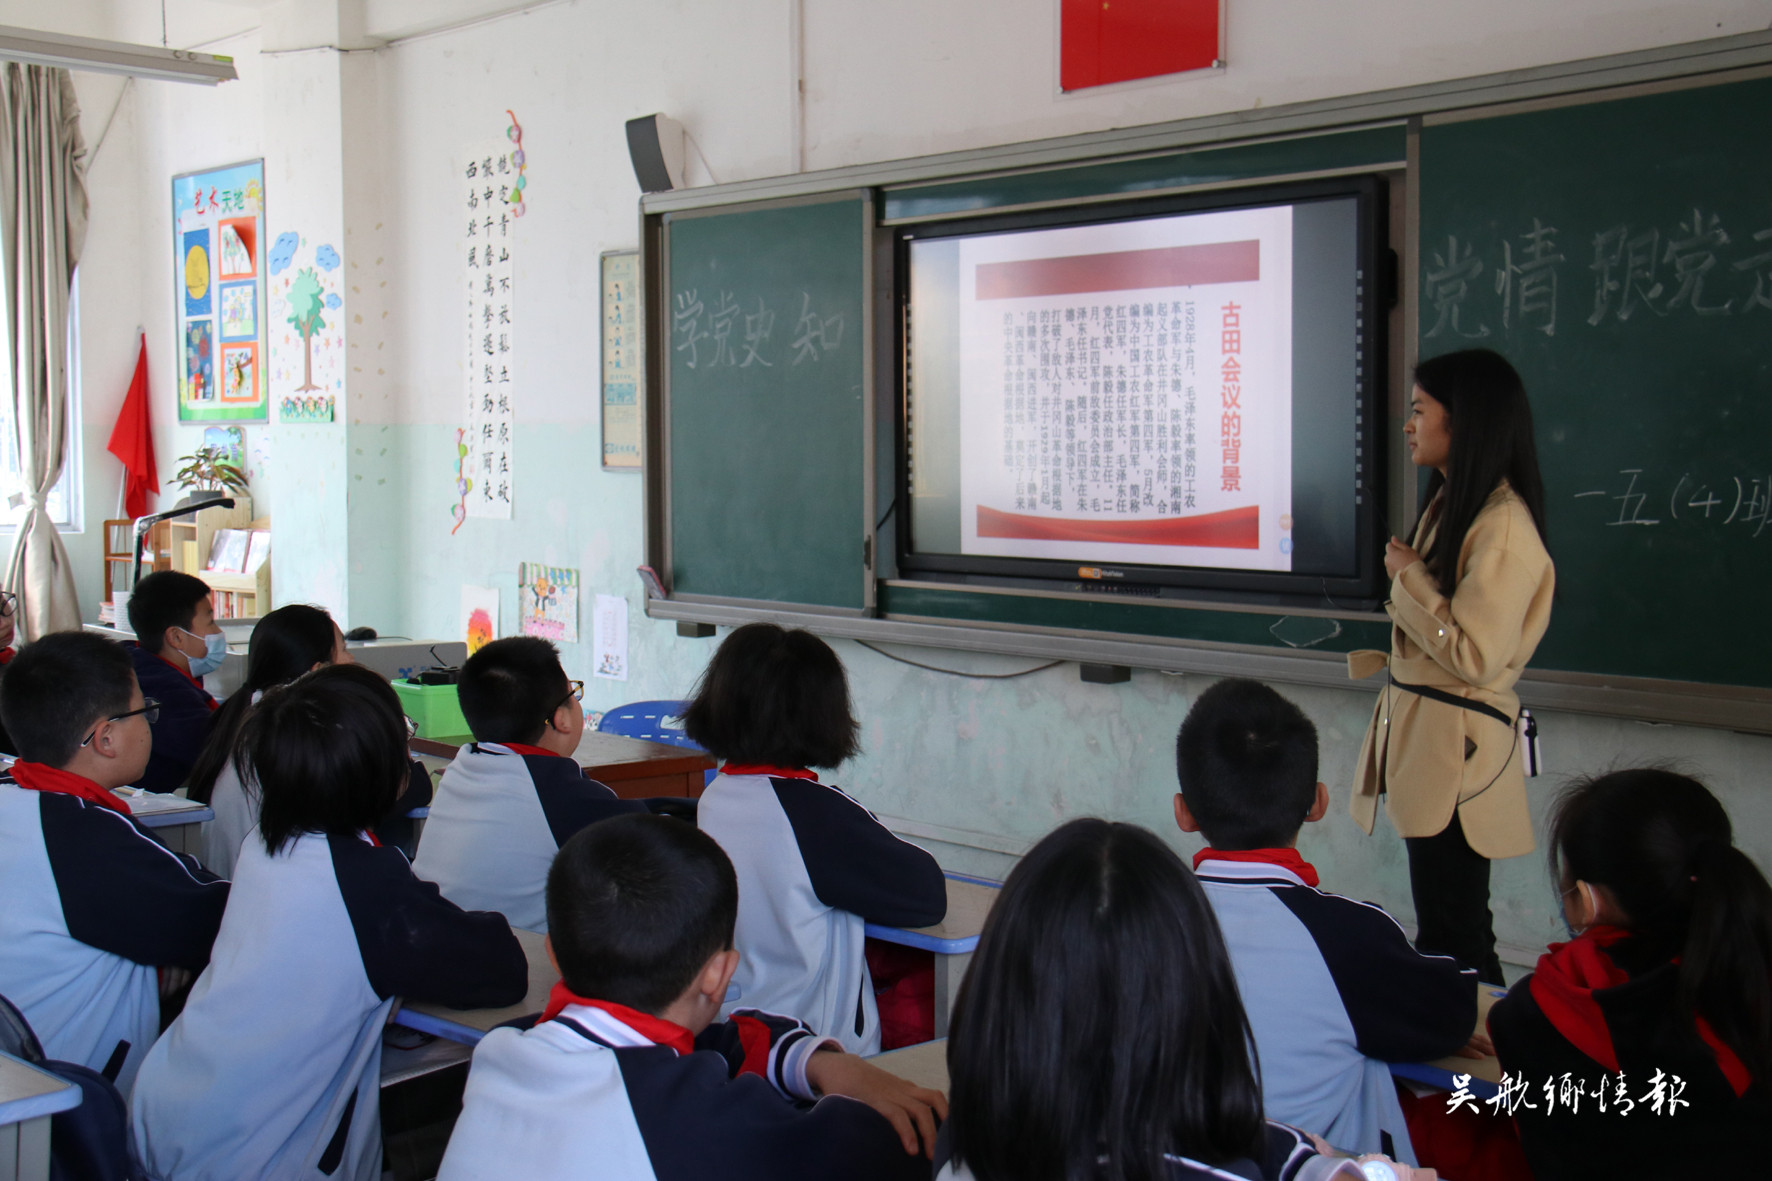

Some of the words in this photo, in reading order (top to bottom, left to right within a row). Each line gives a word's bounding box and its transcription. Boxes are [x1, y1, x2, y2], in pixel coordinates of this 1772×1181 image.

[193, 186, 246, 216] 艺术天地
[1221, 301, 1242, 492] 古田会议的背景
